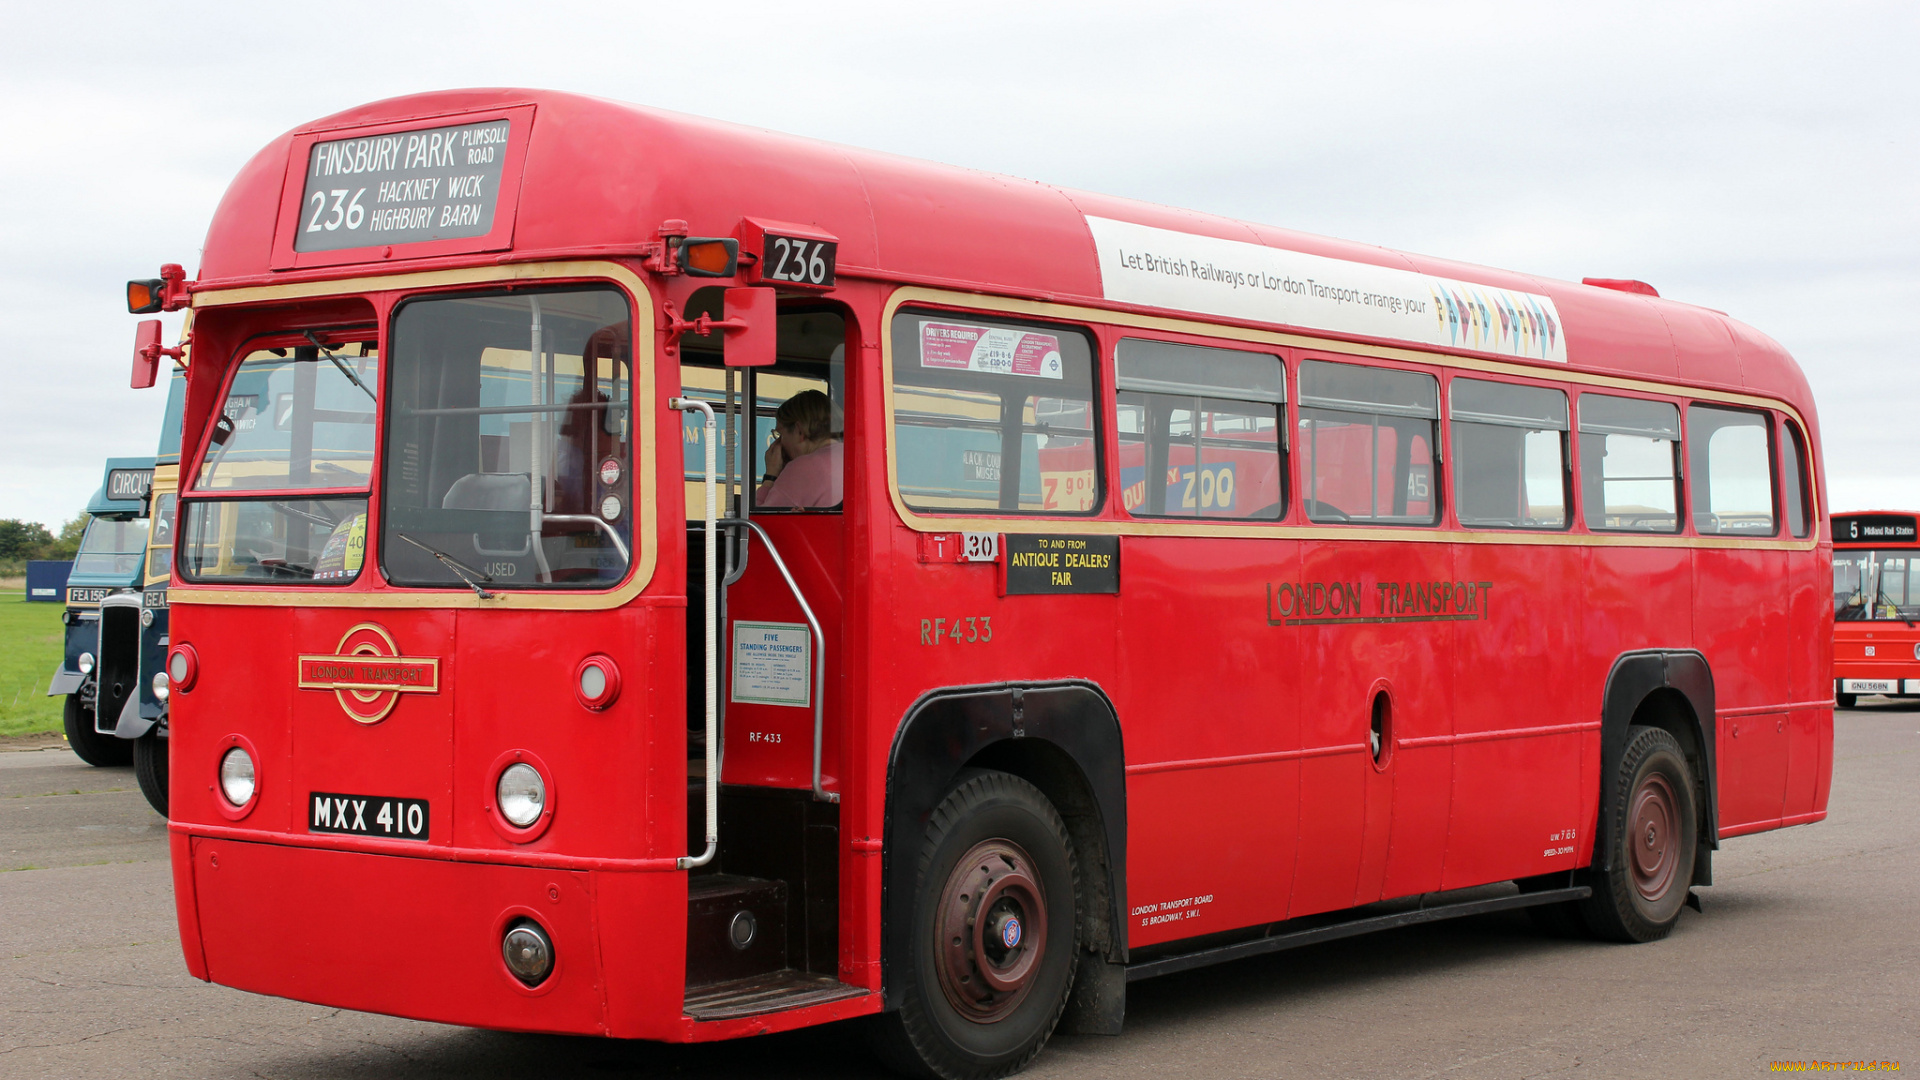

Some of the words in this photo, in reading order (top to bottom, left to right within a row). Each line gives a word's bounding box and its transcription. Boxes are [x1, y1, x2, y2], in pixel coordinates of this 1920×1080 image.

[461, 127, 506, 147] PLIMSOLL
[315, 136, 404, 177] FINSBURY
[404, 131, 459, 169] PARK
[467, 146, 494, 165] ROAD
[377, 177, 441, 203] HACKNEY
[448, 175, 485, 199] WICK
[306, 188, 367, 233] 236
[370, 206, 436, 232] HIGHBURY
[440, 204, 482, 228] BARN
[772, 237, 826, 284] 236
[1119, 249, 1142, 271] Let
[1145, 252, 1189, 278] British
[1190, 260, 1245, 290] Railways
[1247, 271, 1260, 288] or
[1261, 271, 1306, 296] London
[1307, 279, 1359, 305] Transport
[1363, 291, 1402, 314] arrange
[1403, 299, 1427, 315] your
[1435, 296, 1488, 329] PARTY
[926, 327, 950, 338] DRIVERS
[950, 330, 979, 341] REQUIRED
[1043, 478, 1058, 511] Z
[1182, 468, 1234, 509] ZOO
[1850, 521, 1858, 539] 5
[1864, 526, 1884, 536] Midland
[1884, 526, 1895, 536] Rail
[1896, 526, 1914, 536] Station
[349, 535, 364, 550] 40
[969, 535, 993, 557] 30
[1038, 539, 1049, 549] TO
[1050, 539, 1066, 549] AND
[1067, 540, 1086, 550] FROM
[1011, 552, 1059, 568] ANTIQUE
[1065, 553, 1111, 568] DEALERS'
[486, 562, 517, 577] USED
[1051, 571, 1073, 586] FAIR
[72, 589, 89, 601] FEA
[1266, 582, 1361, 627] LONDON
[1377, 581, 1493, 620] TRANSPORT
[764, 633, 779, 642] FIVE
[740, 643, 767, 651] STANDING
[769, 644, 803, 653] PASSENGERS
[311, 665, 355, 680] LONDON
[362, 667, 424, 682] TRANSPORT
[1851, 682, 1867, 690] GNU
[749, 732, 762, 742] RF
[764, 733, 782, 744] 433
[314, 796, 367, 831] MXX
[376, 801, 424, 835] 410
[1131, 904, 1158, 916] LONDON
[1159, 897, 1194, 911] TRANSPORT
[1193, 894, 1214, 906] BOARD
[1141, 918, 1149, 927] 55
